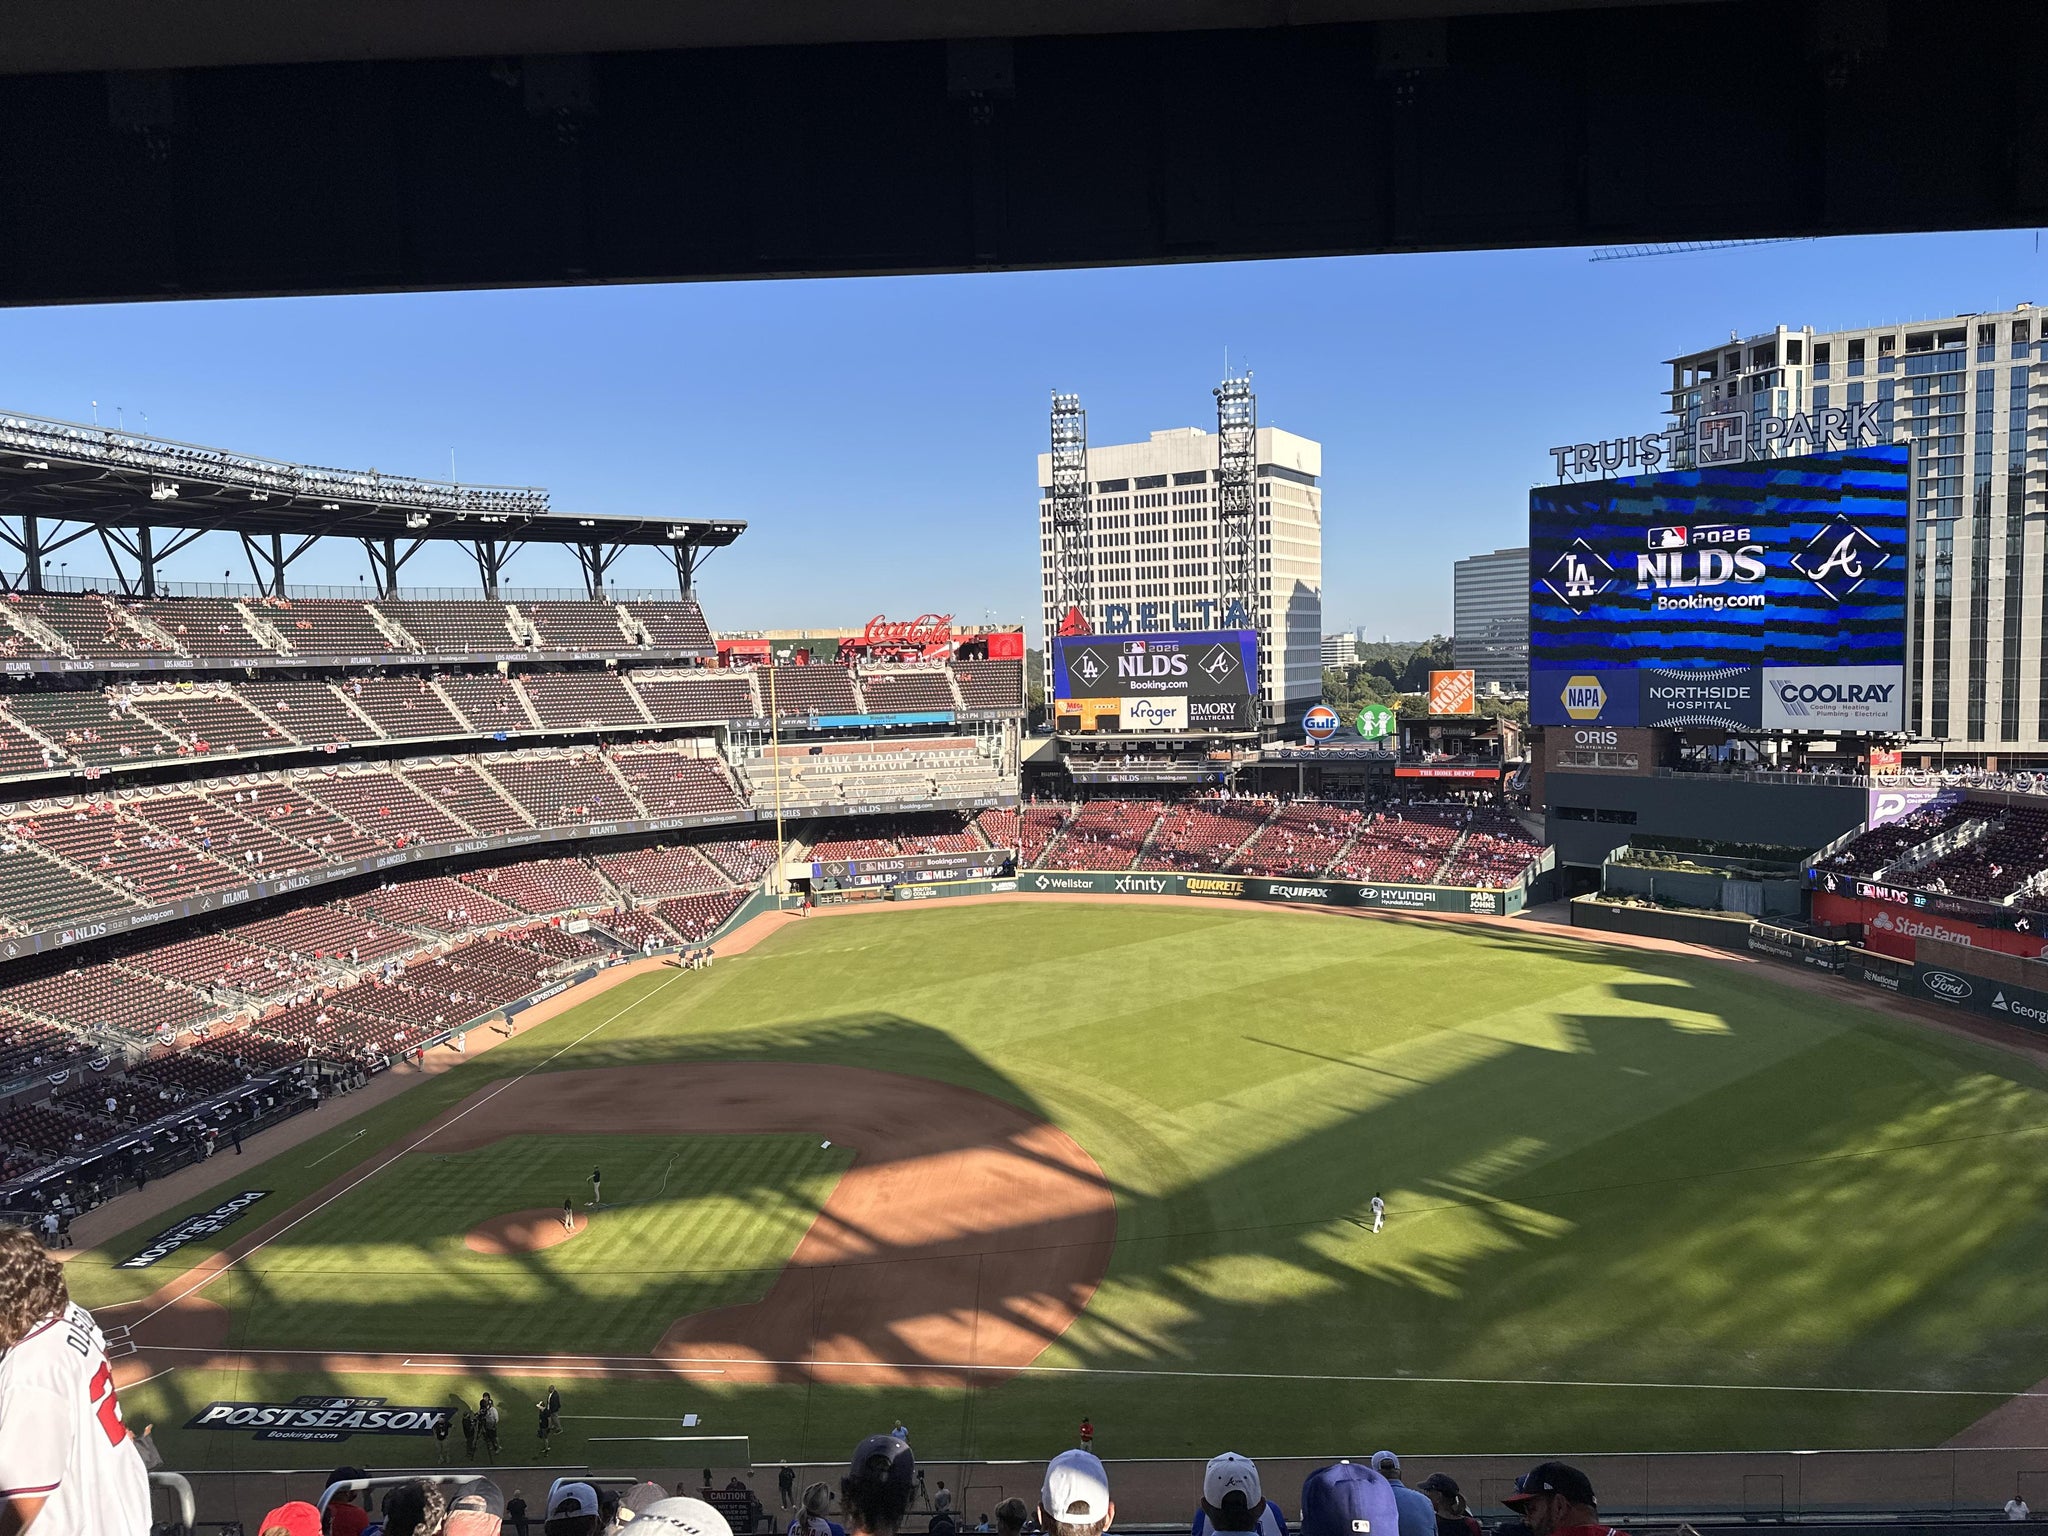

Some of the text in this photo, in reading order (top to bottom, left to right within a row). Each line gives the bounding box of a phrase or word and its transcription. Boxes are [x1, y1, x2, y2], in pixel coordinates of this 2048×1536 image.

[1550, 402, 1883, 476] TRUIST PARK
[1692, 528, 1750, 544] 2026
[1636, 546, 1766, 590] NLDS
[1657, 594, 1765, 612] Booking.com
[1105, 600, 1249, 632] DELTA
[74, 662, 94, 670] NLDS
[350, 656, 372, 664] ATLANTA
[407, 655, 425, 663] NLDS
[1118, 653, 1188, 677] NLDS
[6, 663, 31, 671] ATLANTA
[1130, 680, 1188, 691] Booking.com
[1429, 670, 1473, 714] HOME
[1446, 686, 1473, 713] DEPOT
[1568, 688, 1599, 707] NAPA
[1650, 687, 1750, 699] NORTHSIDE
[1780, 684, 1895, 703] COOLRAY
[1190, 703, 1236, 714] EMORY
[1667, 701, 1731, 710] HOSPITAL
[1131, 700, 1177, 726] Kroger
[1304, 717, 1337, 729] Gulf
[1574, 730, 1618, 745] ORIS
[813, 750, 979, 773] HANK AARON TERRACE
[84, 767, 101, 780] 44
[1119, 774, 1139, 782] NLDS
[1156, 774, 1188, 782] Booking.com
[859, 805, 881, 813] NLDS
[899, 802, 933, 810] Booking.com
[974, 798, 998, 806] ATLANTA
[659, 819, 683, 829] NLDS
[703, 814, 737, 823] Booking.com
[762, 810, 773, 819] LOS
[589, 825, 617, 836] ATLANTA
[464, 842, 488, 851] NLDS
[507, 833, 541, 844] Booking.com
[377, 853, 407, 868] LOS ANGELES
[877, 860, 904, 870] NLDS
[927, 857, 967, 866] Booking.com
[288, 875, 310, 890] NLDS
[327, 867, 357, 878] Booking.com
[872, 875, 898, 884] MLB+
[932, 871, 959, 880] MLB+
[1051, 878, 1093, 889] Wellstar
[1115, 875, 1166, 893] xfinity
[1187, 878, 1245, 891] QUIKRETE
[222, 890, 249, 905] ATLANTA
[1269, 885, 1328, 899] EQUIFAX
[1381, 890, 1436, 902] HYUNDAI
[1470, 892, 1495, 901] PAPA
[1876, 886, 1908, 904] NLDS
[1470, 901, 1495, 909] JOHNS
[75, 923, 107, 940] NLDS
[131, 909, 174, 924] Booking.com
[1871, 973, 1900, 987] National
[1930, 973, 1963, 995] Ford
[122, 1192, 266, 1267] POSTSEASON
[197, 1407, 445, 1431] POSTSEASON
[267, 1431, 338, 1440] Booking.com
[710, 1492, 746, 1500] CAUTION
